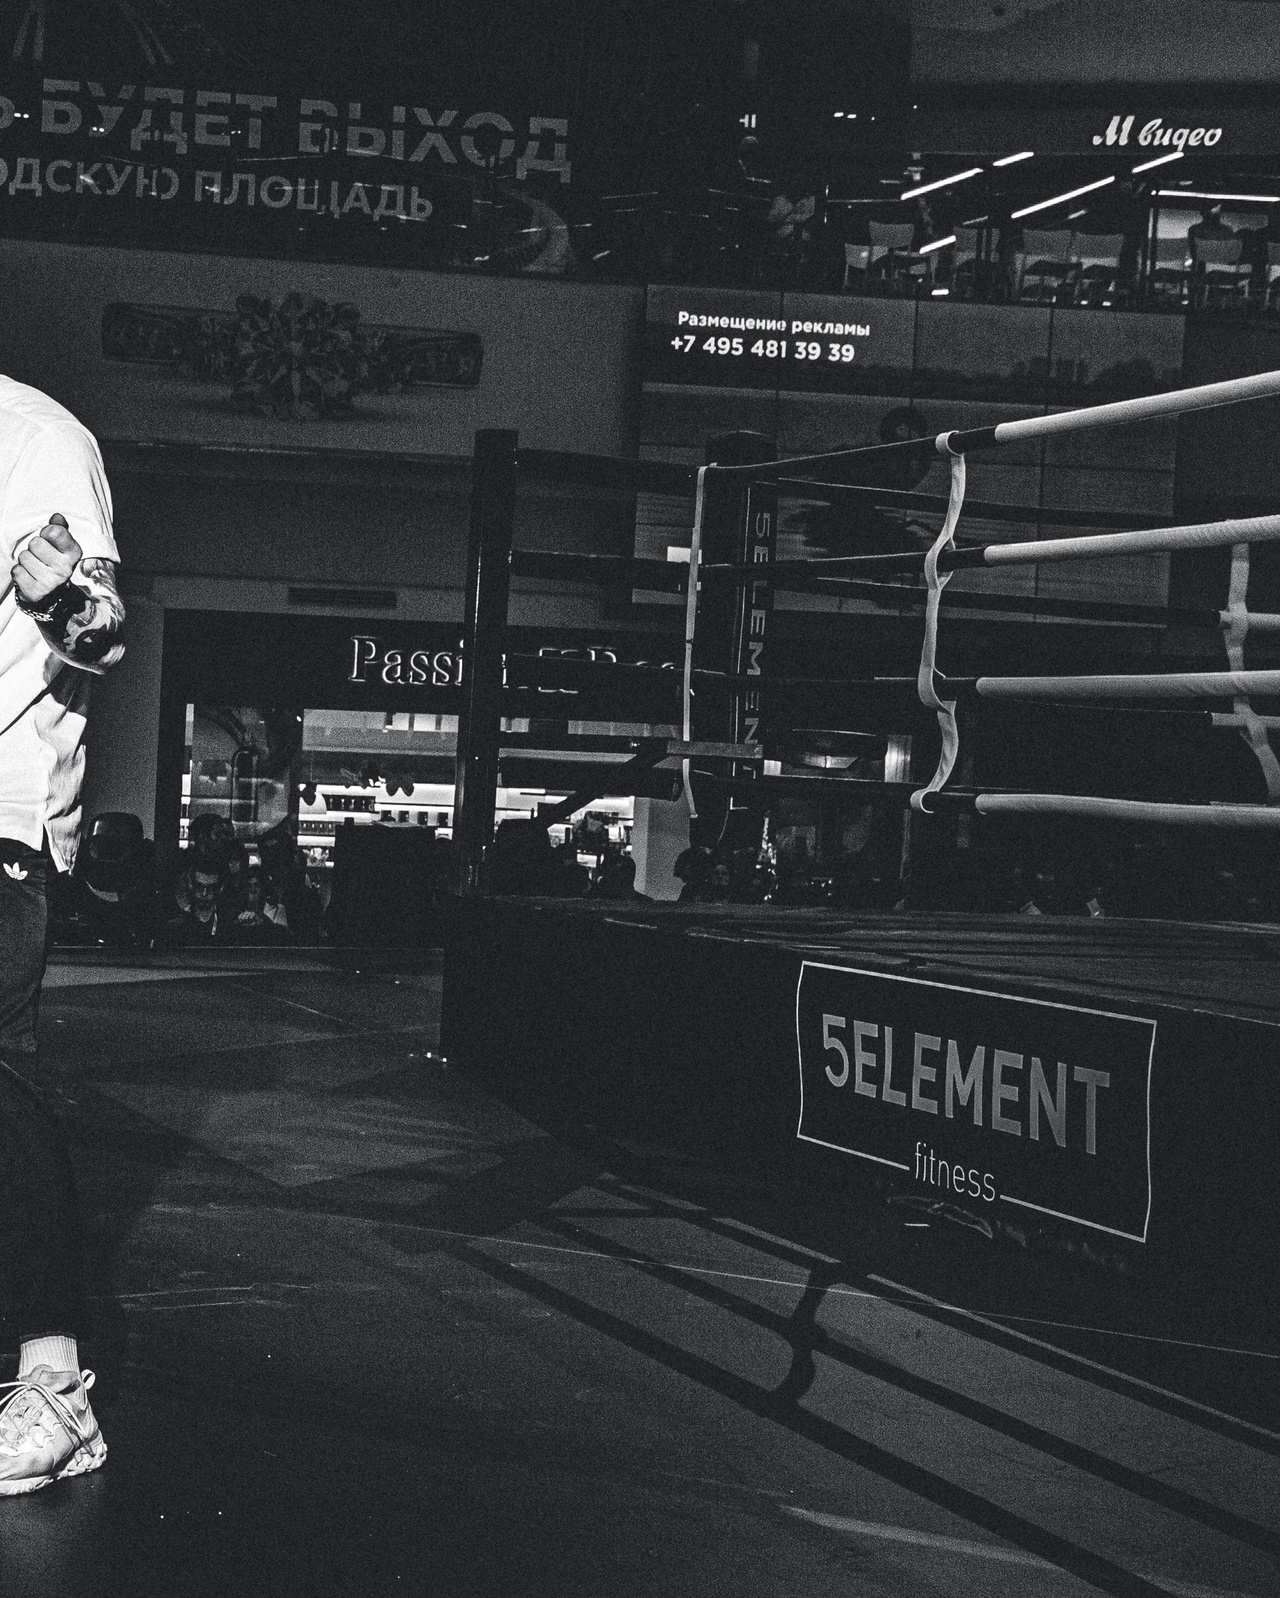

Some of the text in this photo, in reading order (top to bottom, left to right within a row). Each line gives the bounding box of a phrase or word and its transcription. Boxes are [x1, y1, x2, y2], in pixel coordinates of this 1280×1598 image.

[40, 77, 278, 155] БУДЕТ
[298, 98, 572, 184] ВЫХОД
[194, 170, 434, 222] ПЛОЩАДЬ
[671, 335, 855, 362] +7 495 481 39 39
[677, 311, 870, 336] Размещение рекламы
[821, 1012, 1111, 1156] 5ELEMENT
[914, 1141, 997, 1202] fitness
